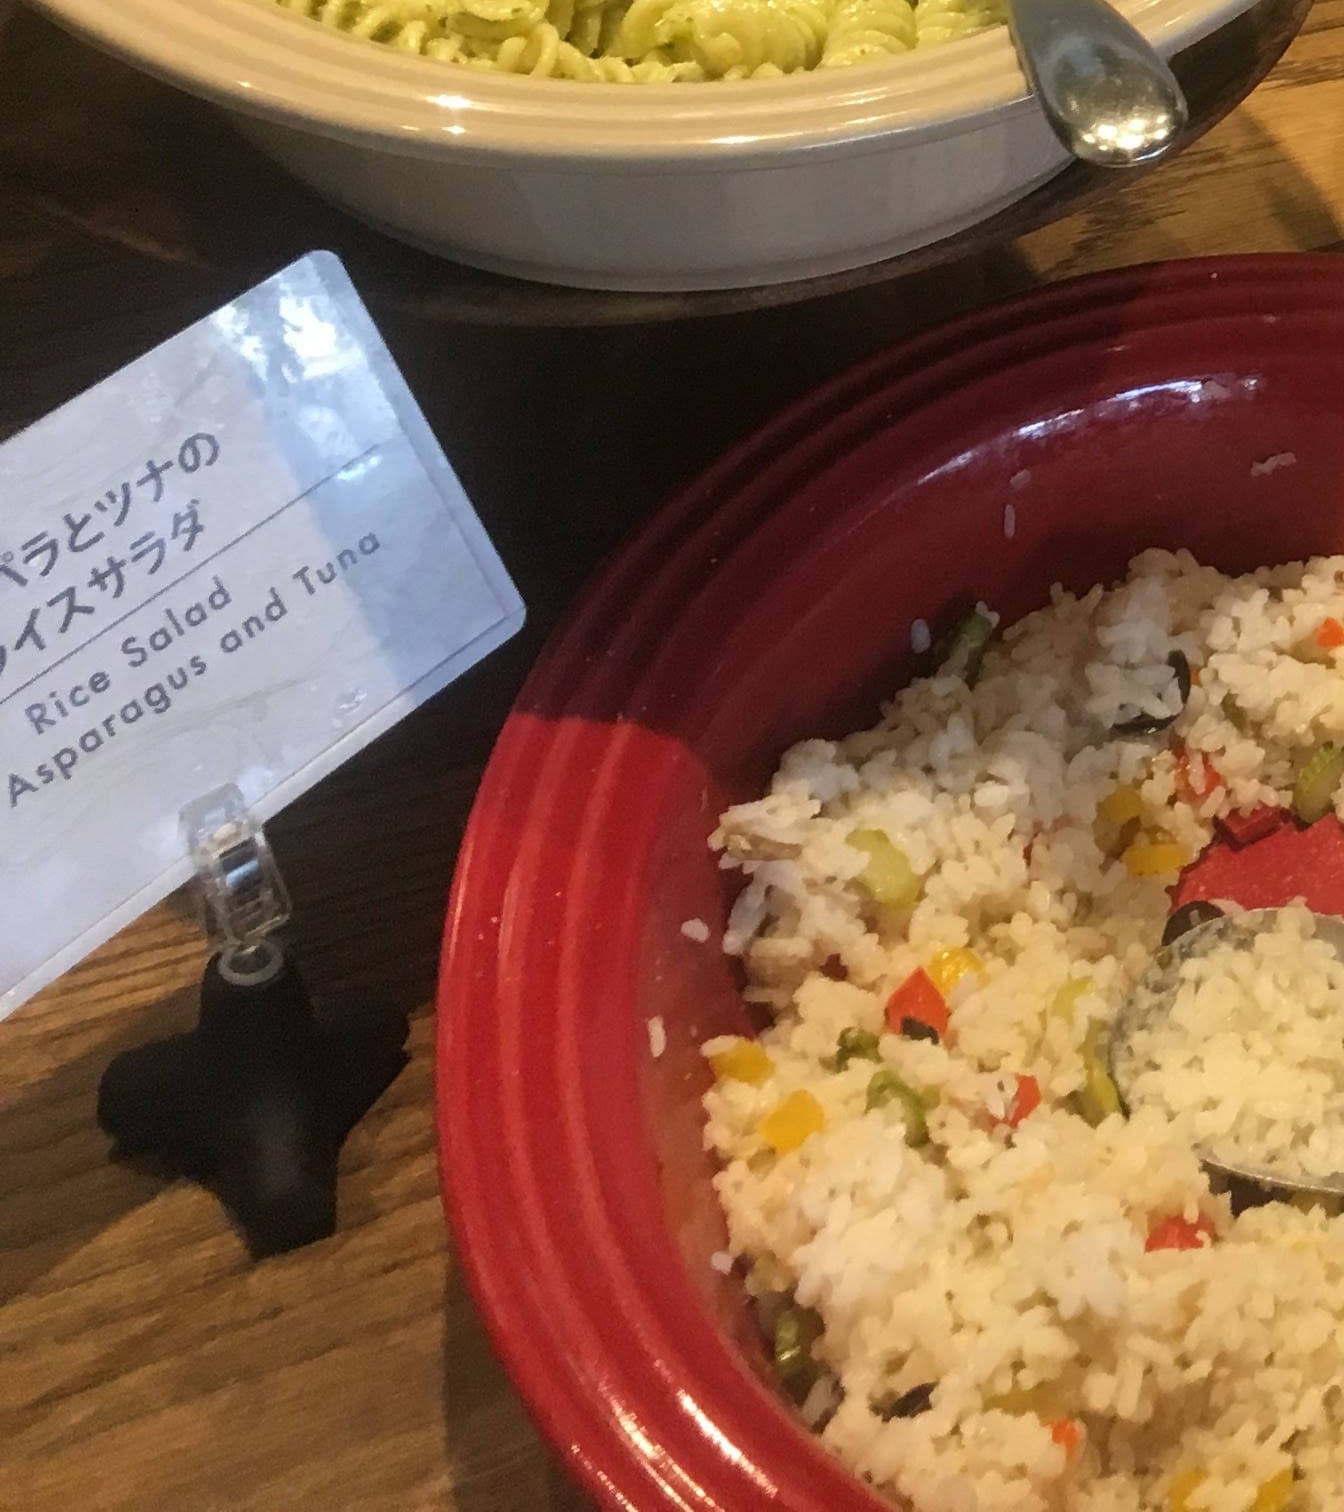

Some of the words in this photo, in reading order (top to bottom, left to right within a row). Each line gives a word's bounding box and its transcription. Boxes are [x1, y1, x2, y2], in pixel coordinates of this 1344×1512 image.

[0, 432, 220, 587] パラとツナの
[0, 499, 205, 676] イスサラダ
[7, 654, 207, 808] Asparagus
[219, 587, 288, 654] and
[292, 531, 381, 596] Tuna
[25, 670, 110, 735] Rice
[121, 575, 232, 667] Salad
